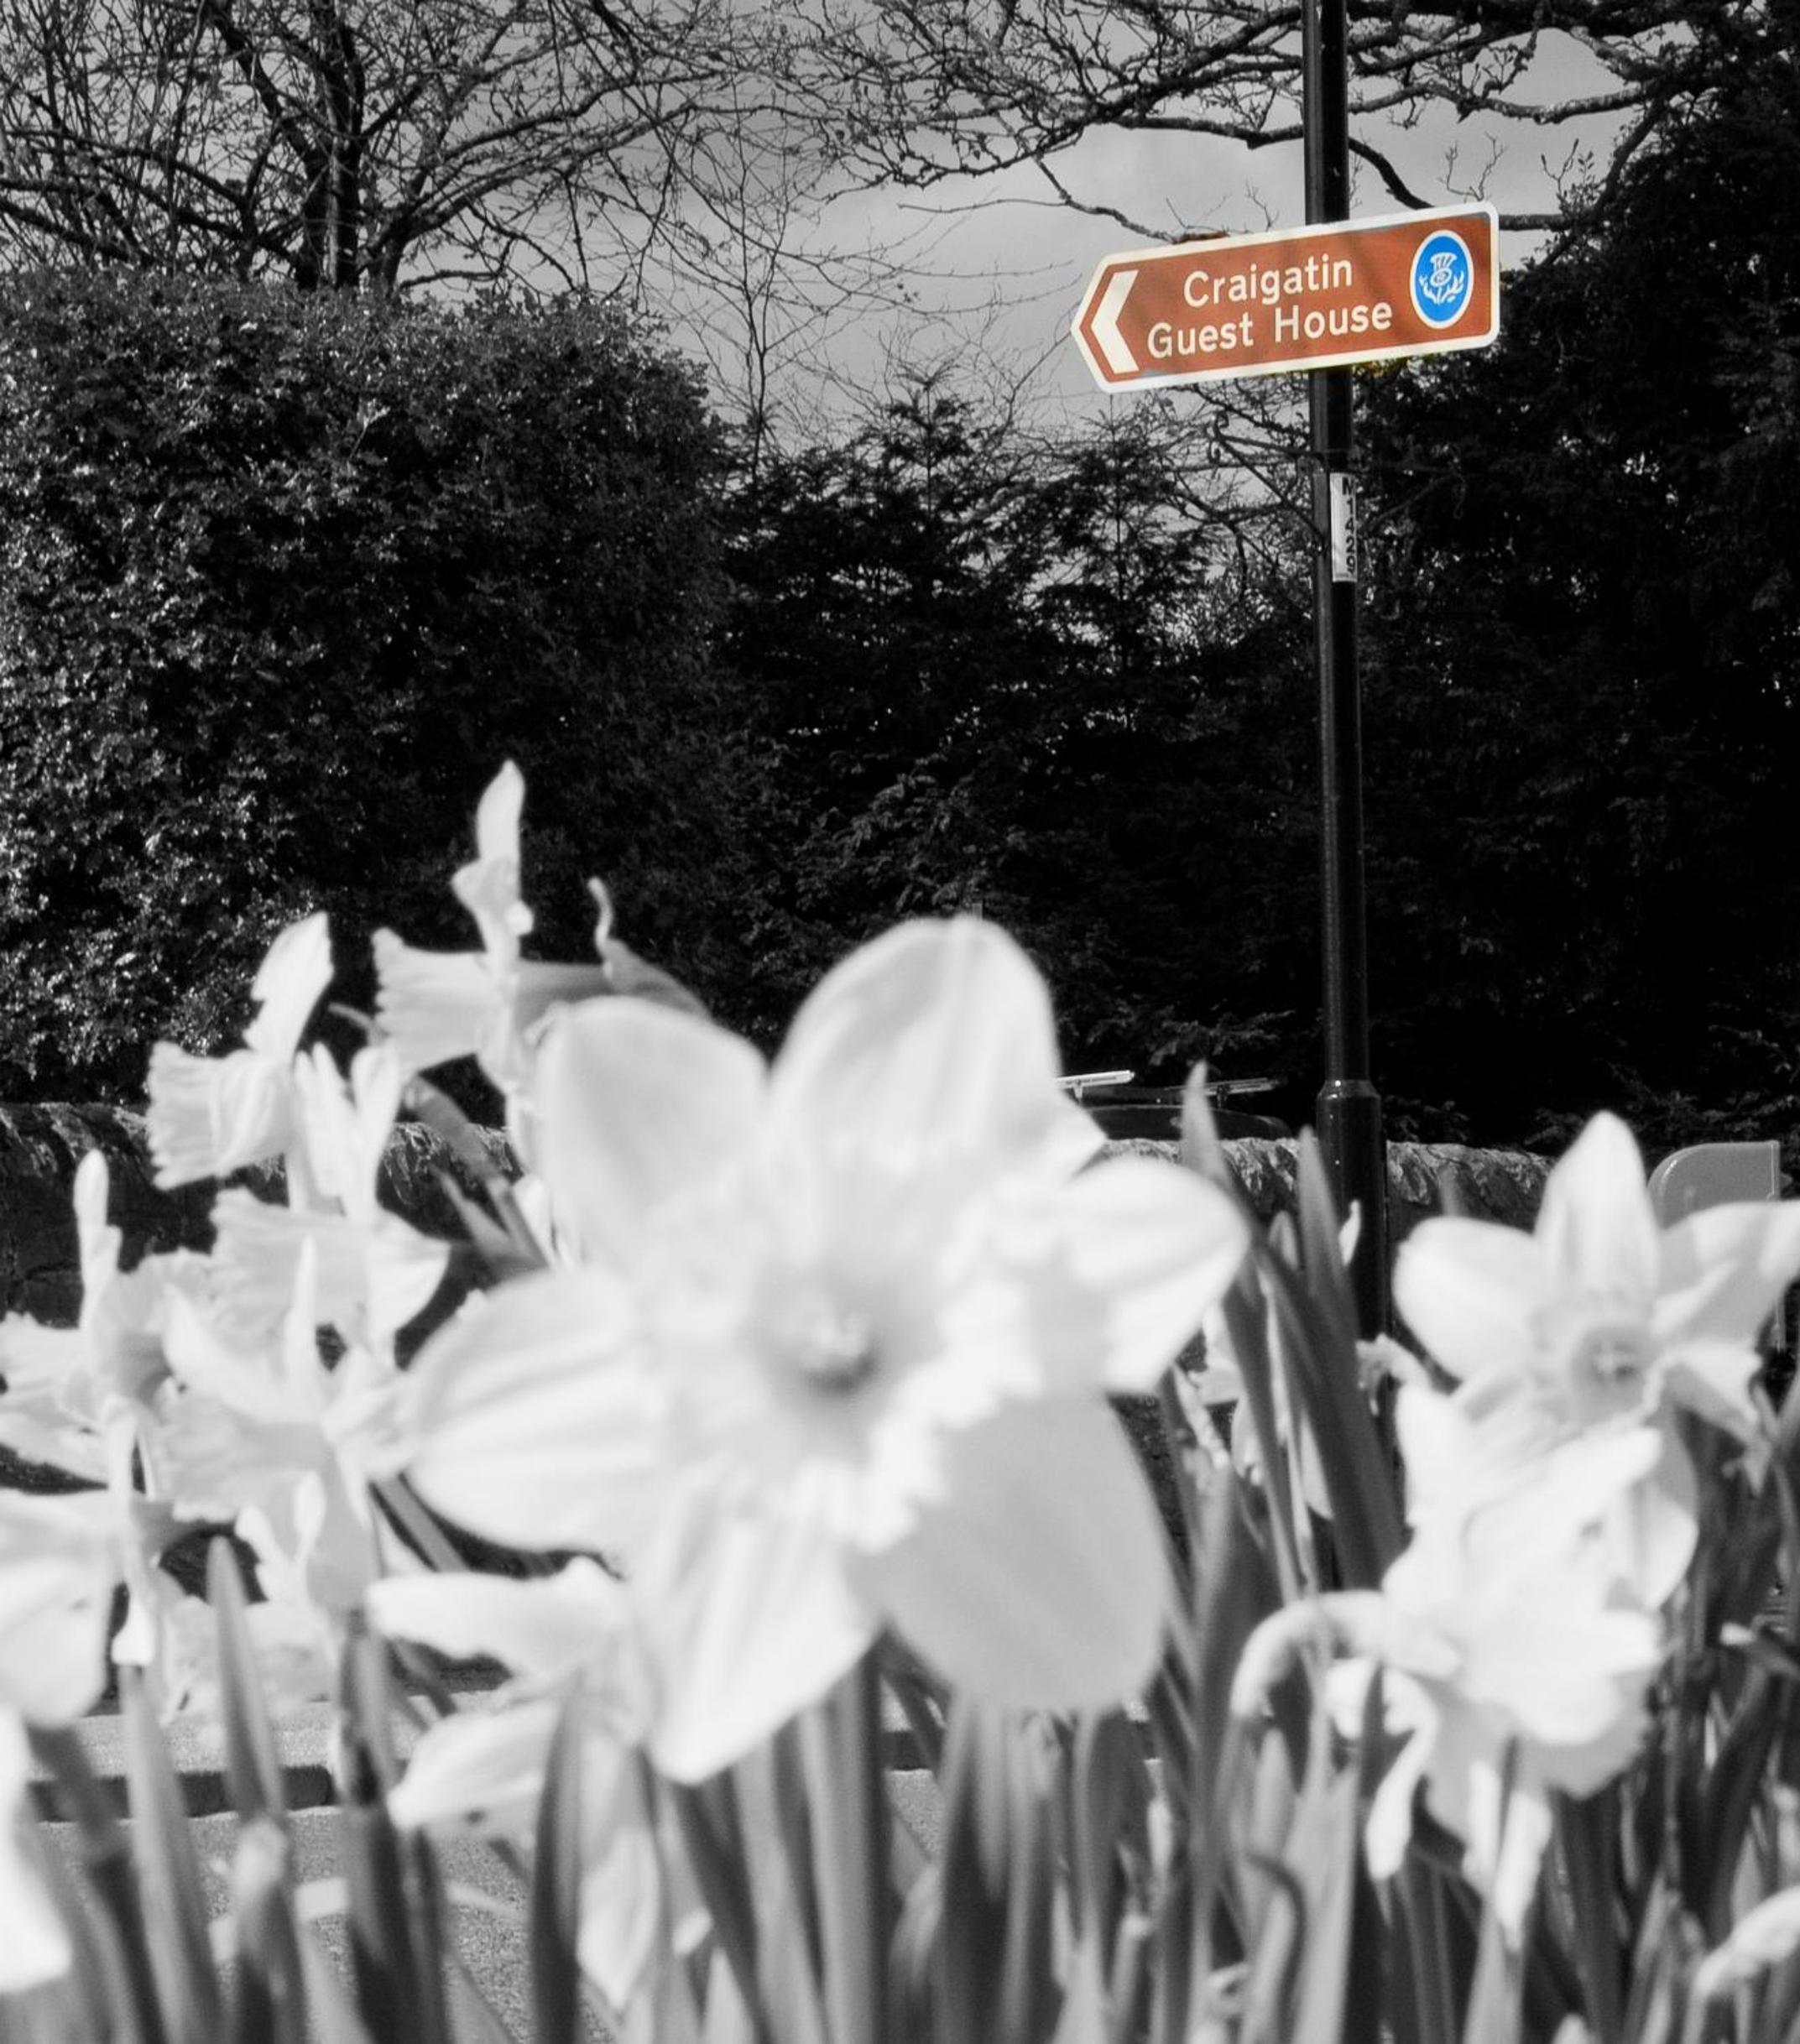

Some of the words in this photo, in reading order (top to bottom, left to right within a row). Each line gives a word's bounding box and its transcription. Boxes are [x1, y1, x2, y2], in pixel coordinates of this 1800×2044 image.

[1183, 253, 1353, 308] Craigatin
[1147, 311, 1255, 359] Guest
[1274, 302, 1393, 343] House
